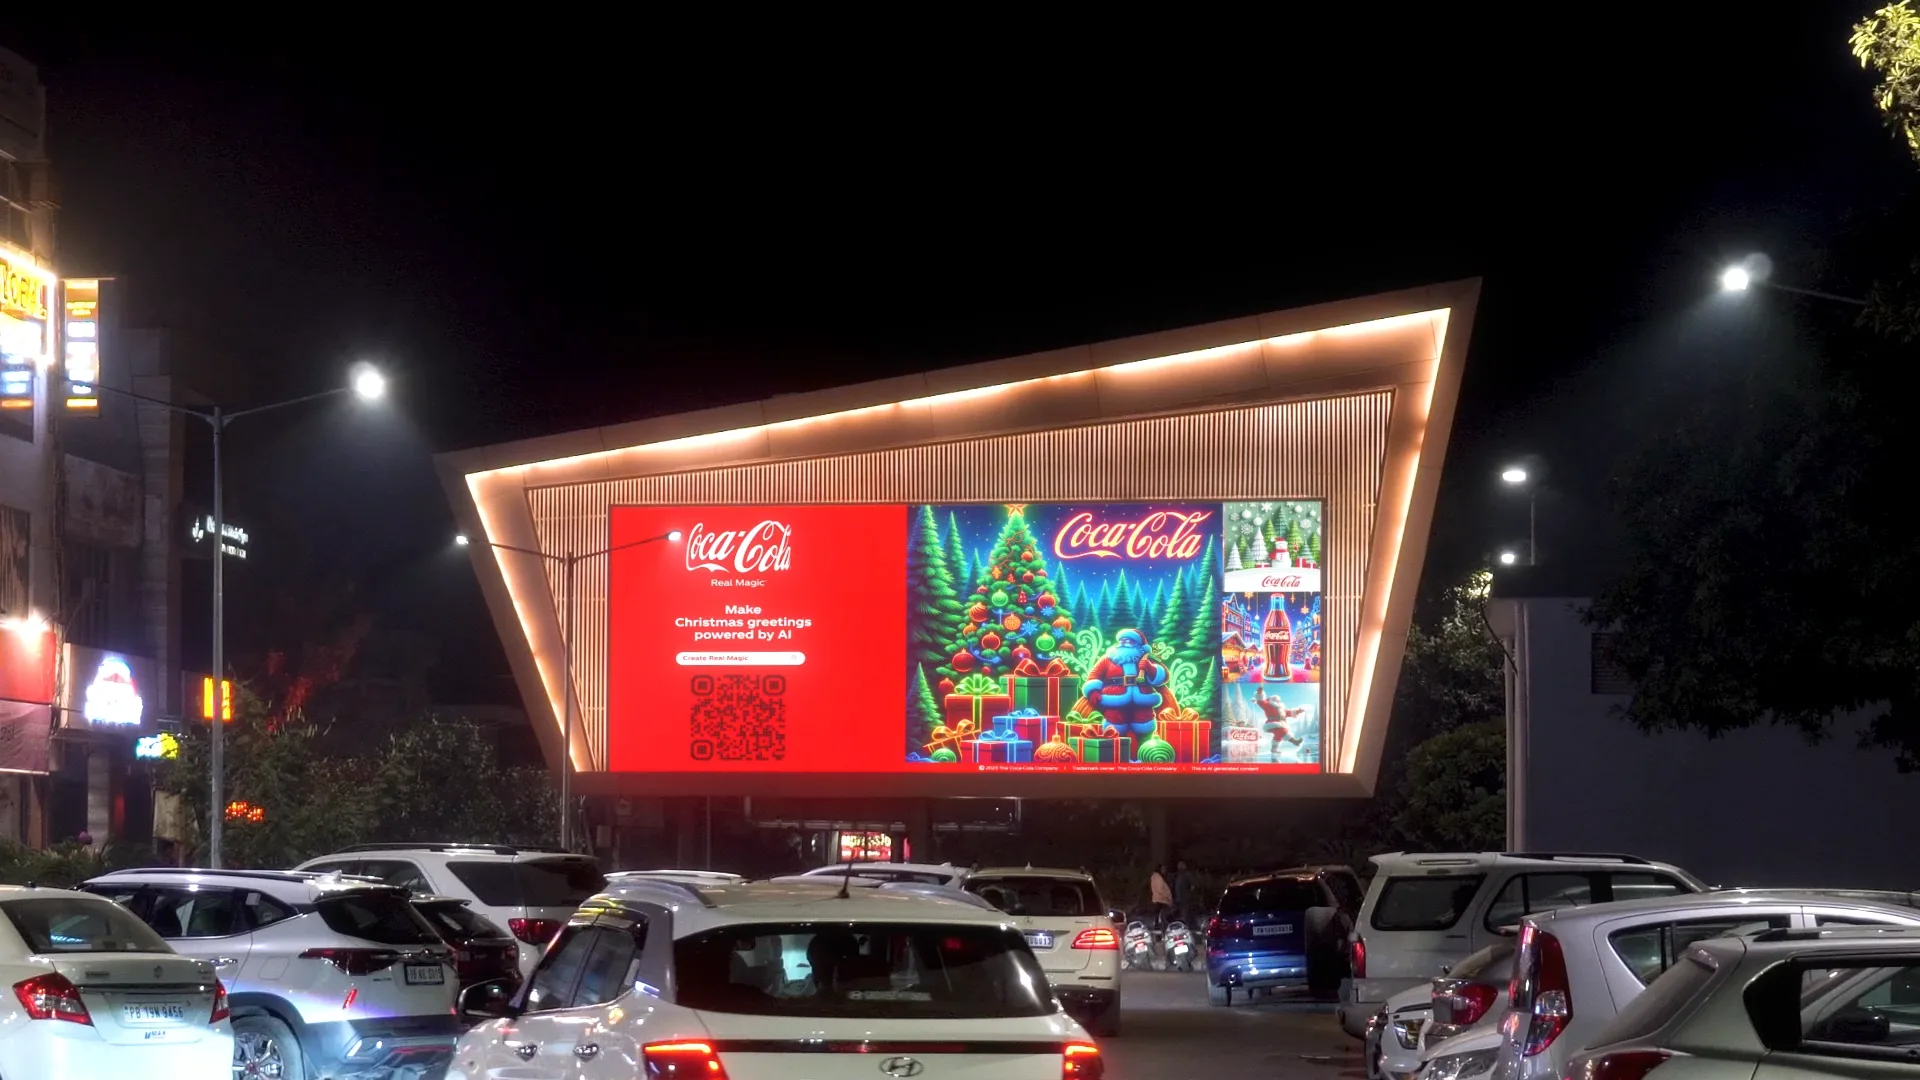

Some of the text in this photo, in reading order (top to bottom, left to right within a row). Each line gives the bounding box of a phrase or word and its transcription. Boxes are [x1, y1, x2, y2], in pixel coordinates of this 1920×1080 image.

[1054, 511, 1213, 559] Coca-Cola
[685, 520, 792, 573] Coca-Cola
[710, 579, 733, 587] Real
[725, 605, 762, 615] Make
[674, 617, 812, 629] Christmas greetings
[694, 629, 792, 642] powered by AI
[130, 1006, 141, 1019] PB
